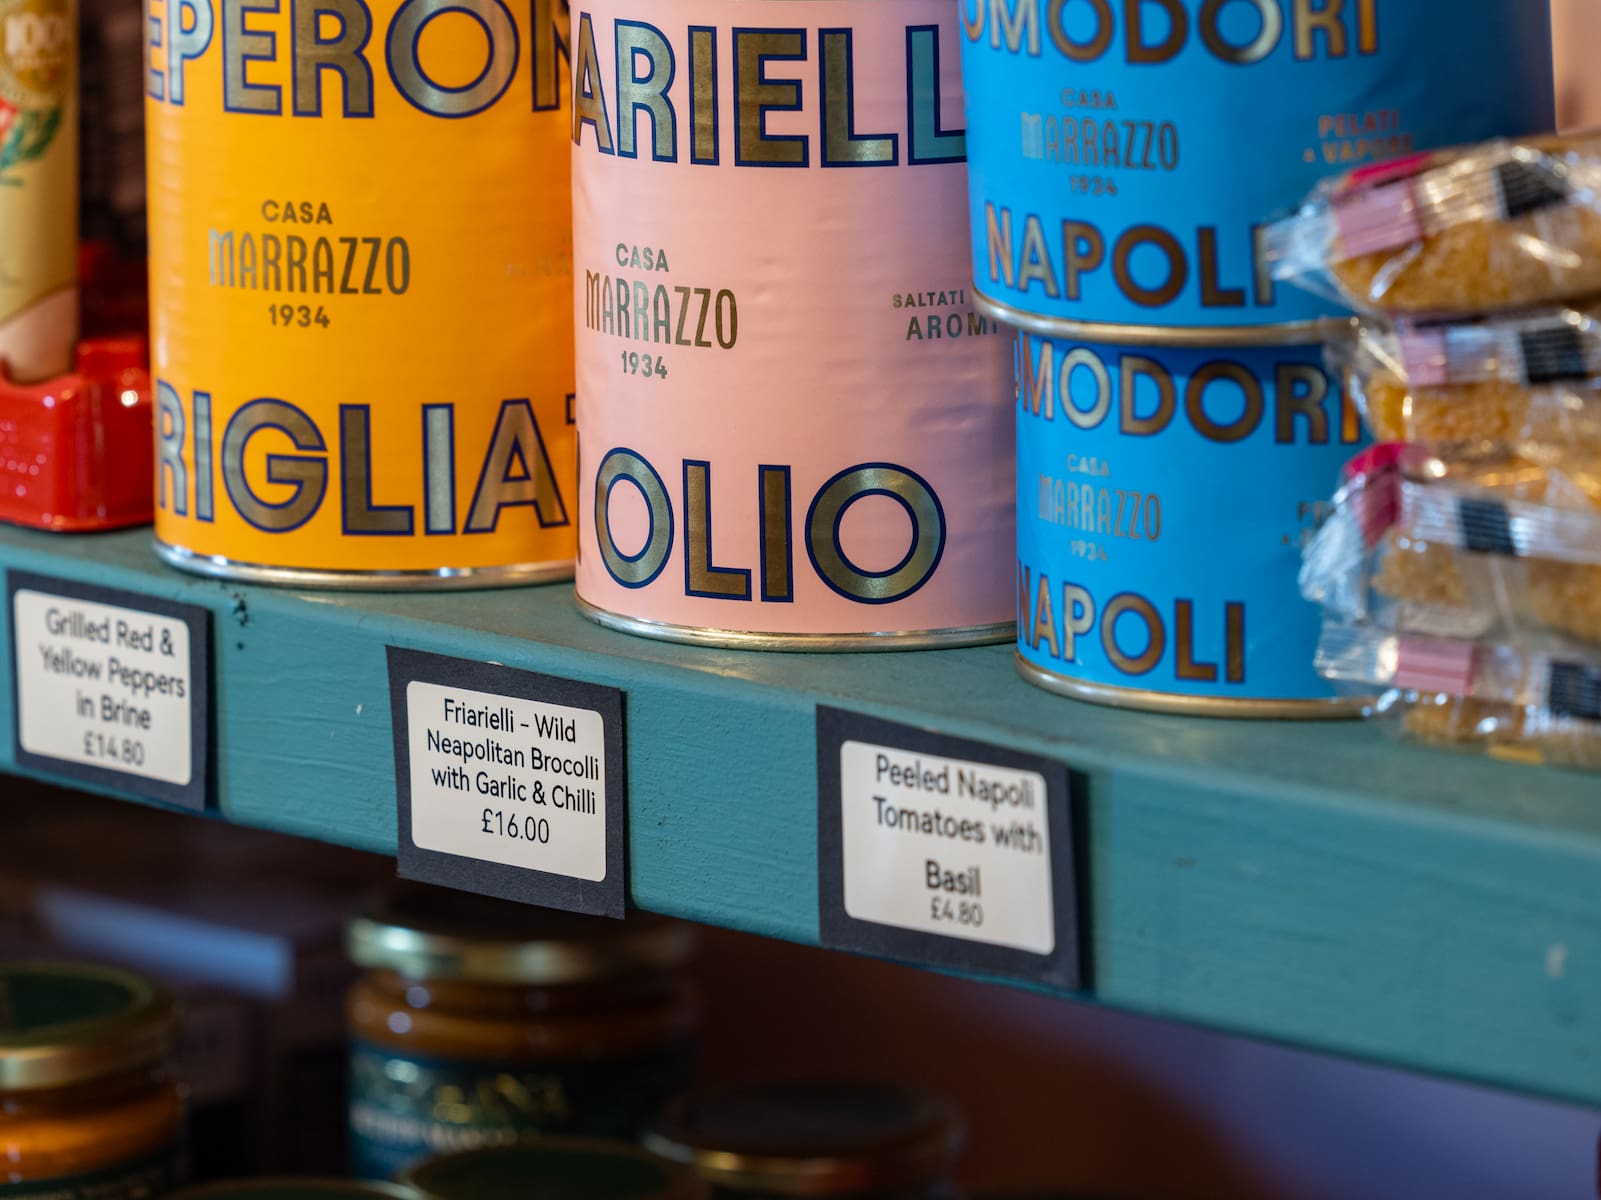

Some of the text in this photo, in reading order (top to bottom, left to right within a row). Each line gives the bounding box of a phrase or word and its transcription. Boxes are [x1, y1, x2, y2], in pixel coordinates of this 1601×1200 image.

[572, 11, 966, 168] ARIELL
[1062, 87, 1117, 109] CASA
[1021, 111, 1179, 171] MARRAZZO
[261, 200, 333, 225] CASA
[208, 228, 411, 295] MARRAZZO
[615, 242, 670, 273] CASA
[268, 304, 331, 328] 1934
[586, 269, 738, 350] MARRAZZO
[892, 289, 964, 309] SALTATI
[621, 350, 668, 379] 1934
[156, 378, 576, 537] RIGLIA
[1066, 453, 1111, 478] CASA
[594, 446, 947, 605] OLIO
[1039, 473, 1161, 543] MARRAZZO
[46, 608, 174, 657] Grilled Red &
[1018, 558, 1247, 684] NAPOLI
[38, 643, 185, 698] Yellow Peppers
[101, 695, 152, 730] Brine
[444, 698, 514, 732] Friarielli
[534, 713, 576, 743] Wild
[427, 729, 599, 781] Neapolitan Brocolli
[431, 766, 596, 815] with Garlic & Chilli
[876, 755, 1034, 811] Peeled Napoli
[482, 808, 550, 844] £16.00
[872, 796, 1043, 853] Tomatoes with
[925, 859, 982, 897] Basil
